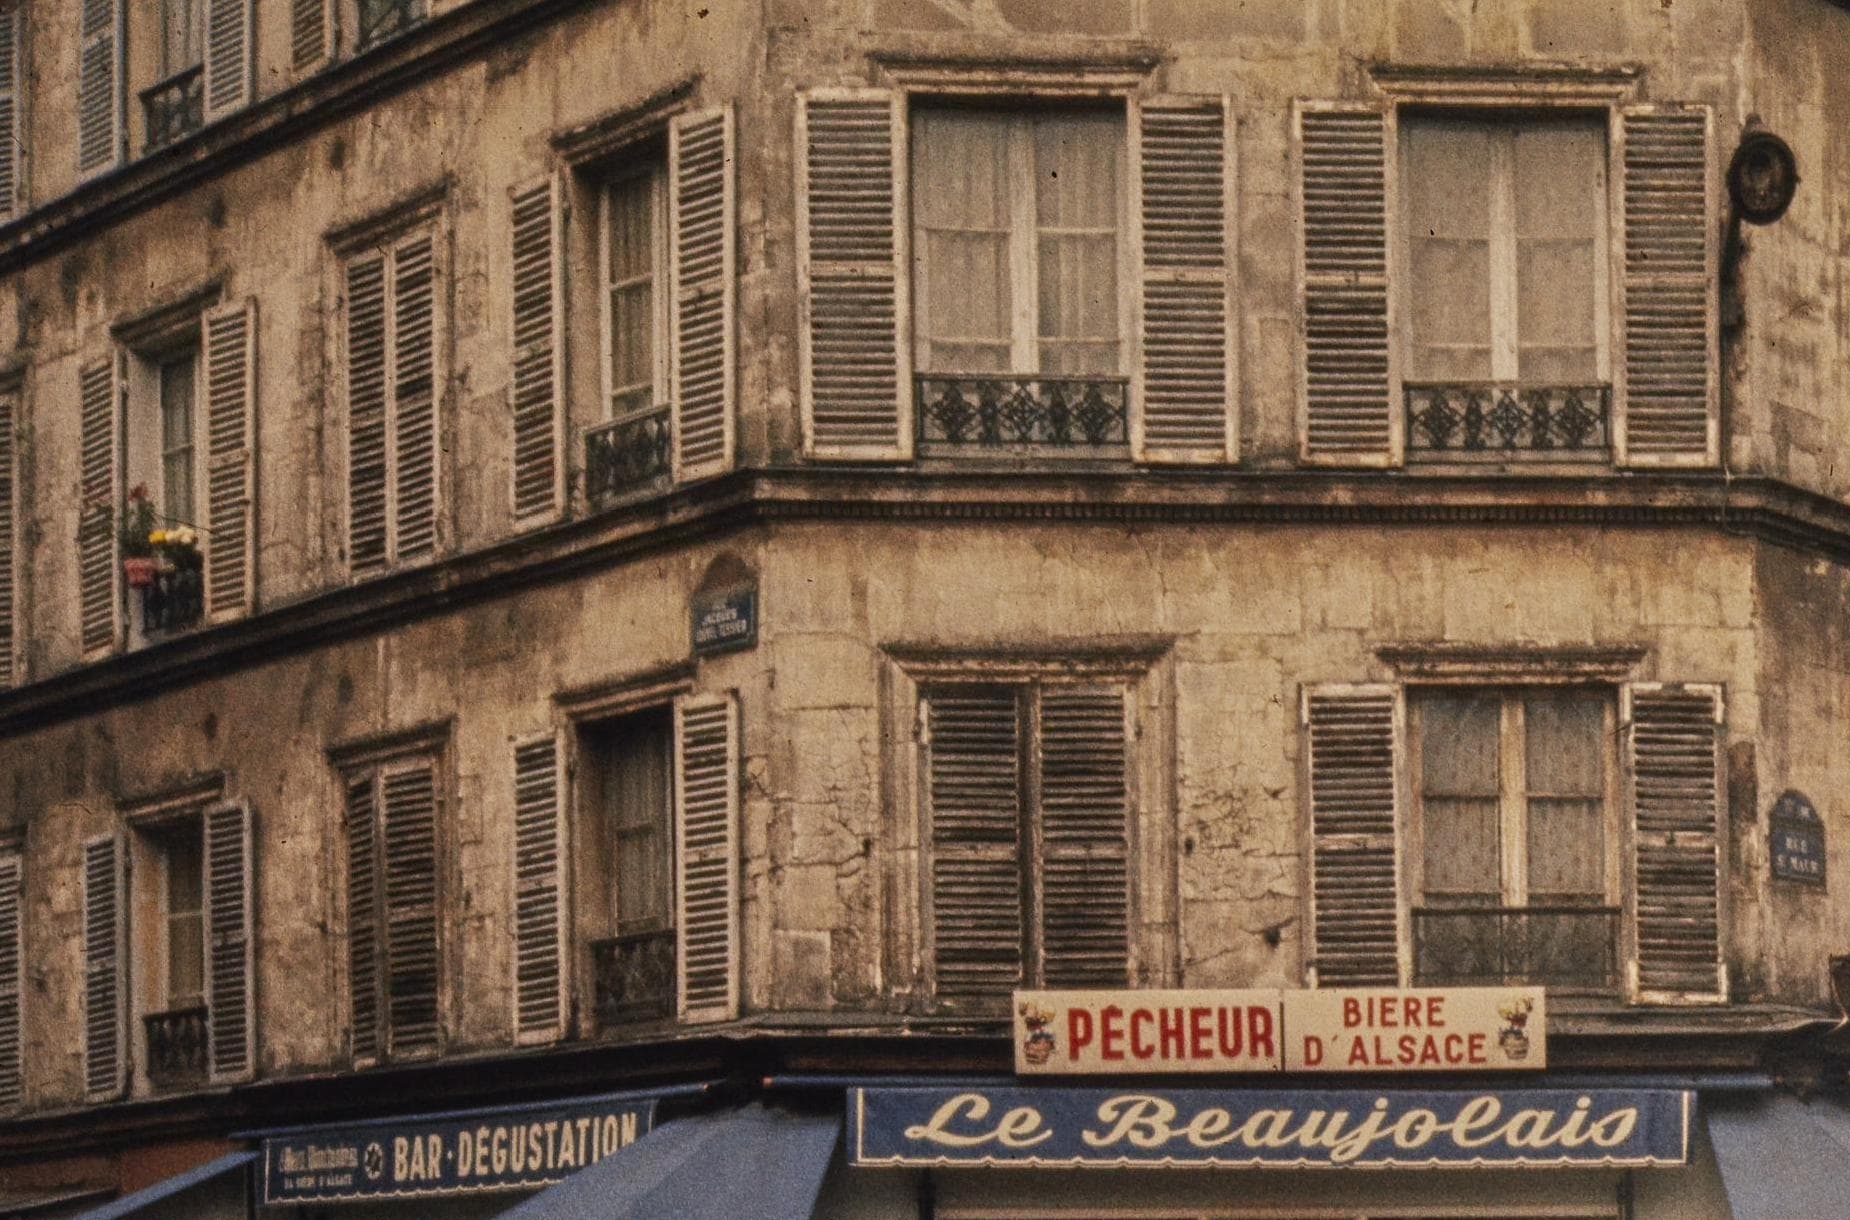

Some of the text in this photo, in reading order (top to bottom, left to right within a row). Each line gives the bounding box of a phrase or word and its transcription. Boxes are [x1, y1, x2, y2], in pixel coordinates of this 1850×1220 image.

[1068, 1004, 1275, 1062] PÊCHEUR
[1342, 997, 1446, 1029] BIERE
[904, 1089, 1642, 1163] Le Beaujolais
[393, 1133, 442, 1182] BAR
